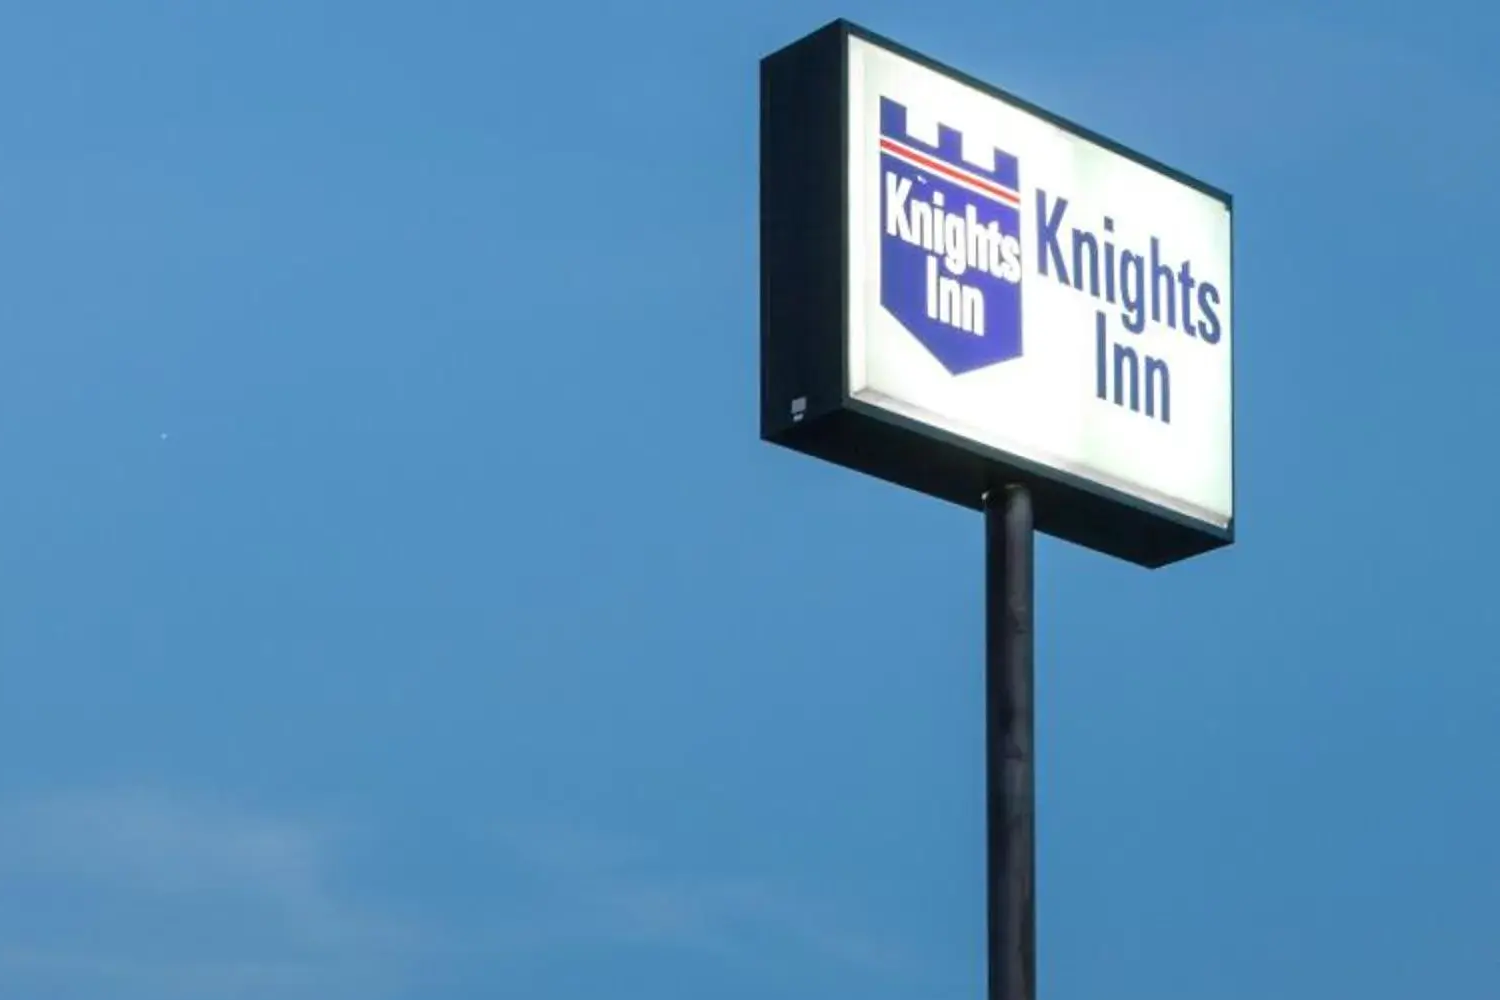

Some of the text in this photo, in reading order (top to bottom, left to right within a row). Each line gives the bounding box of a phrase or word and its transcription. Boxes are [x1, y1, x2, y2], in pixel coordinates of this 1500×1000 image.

[886, 171, 1021, 283] Knights
[1036, 188, 1221, 345] Knights
[927, 256, 985, 335] Inn
[1096, 311, 1171, 424] Inn
